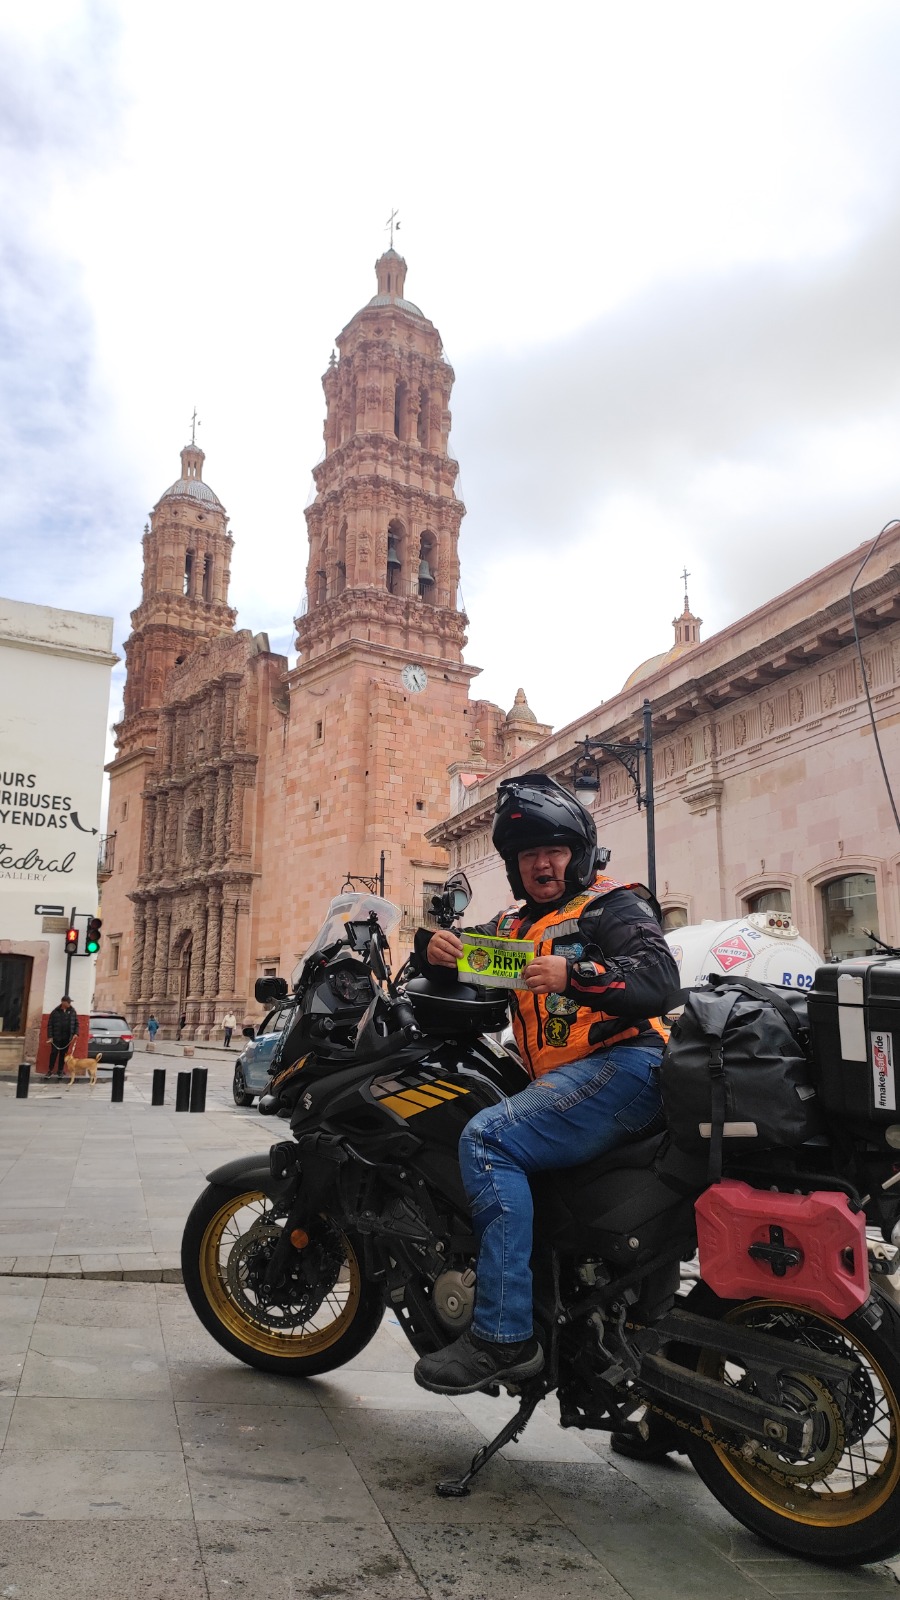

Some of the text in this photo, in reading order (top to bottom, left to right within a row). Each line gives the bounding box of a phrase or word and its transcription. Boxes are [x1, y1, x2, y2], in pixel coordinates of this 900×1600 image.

[0, 771, 36, 788] URS
[0, 790, 72, 811] RIBUSES
[493, 954, 527, 971] RRM
[724, 956, 734, 966] 2
[782, 972, 813, 988] R 02
[875, 1035, 887, 1107] #makeasaferide
